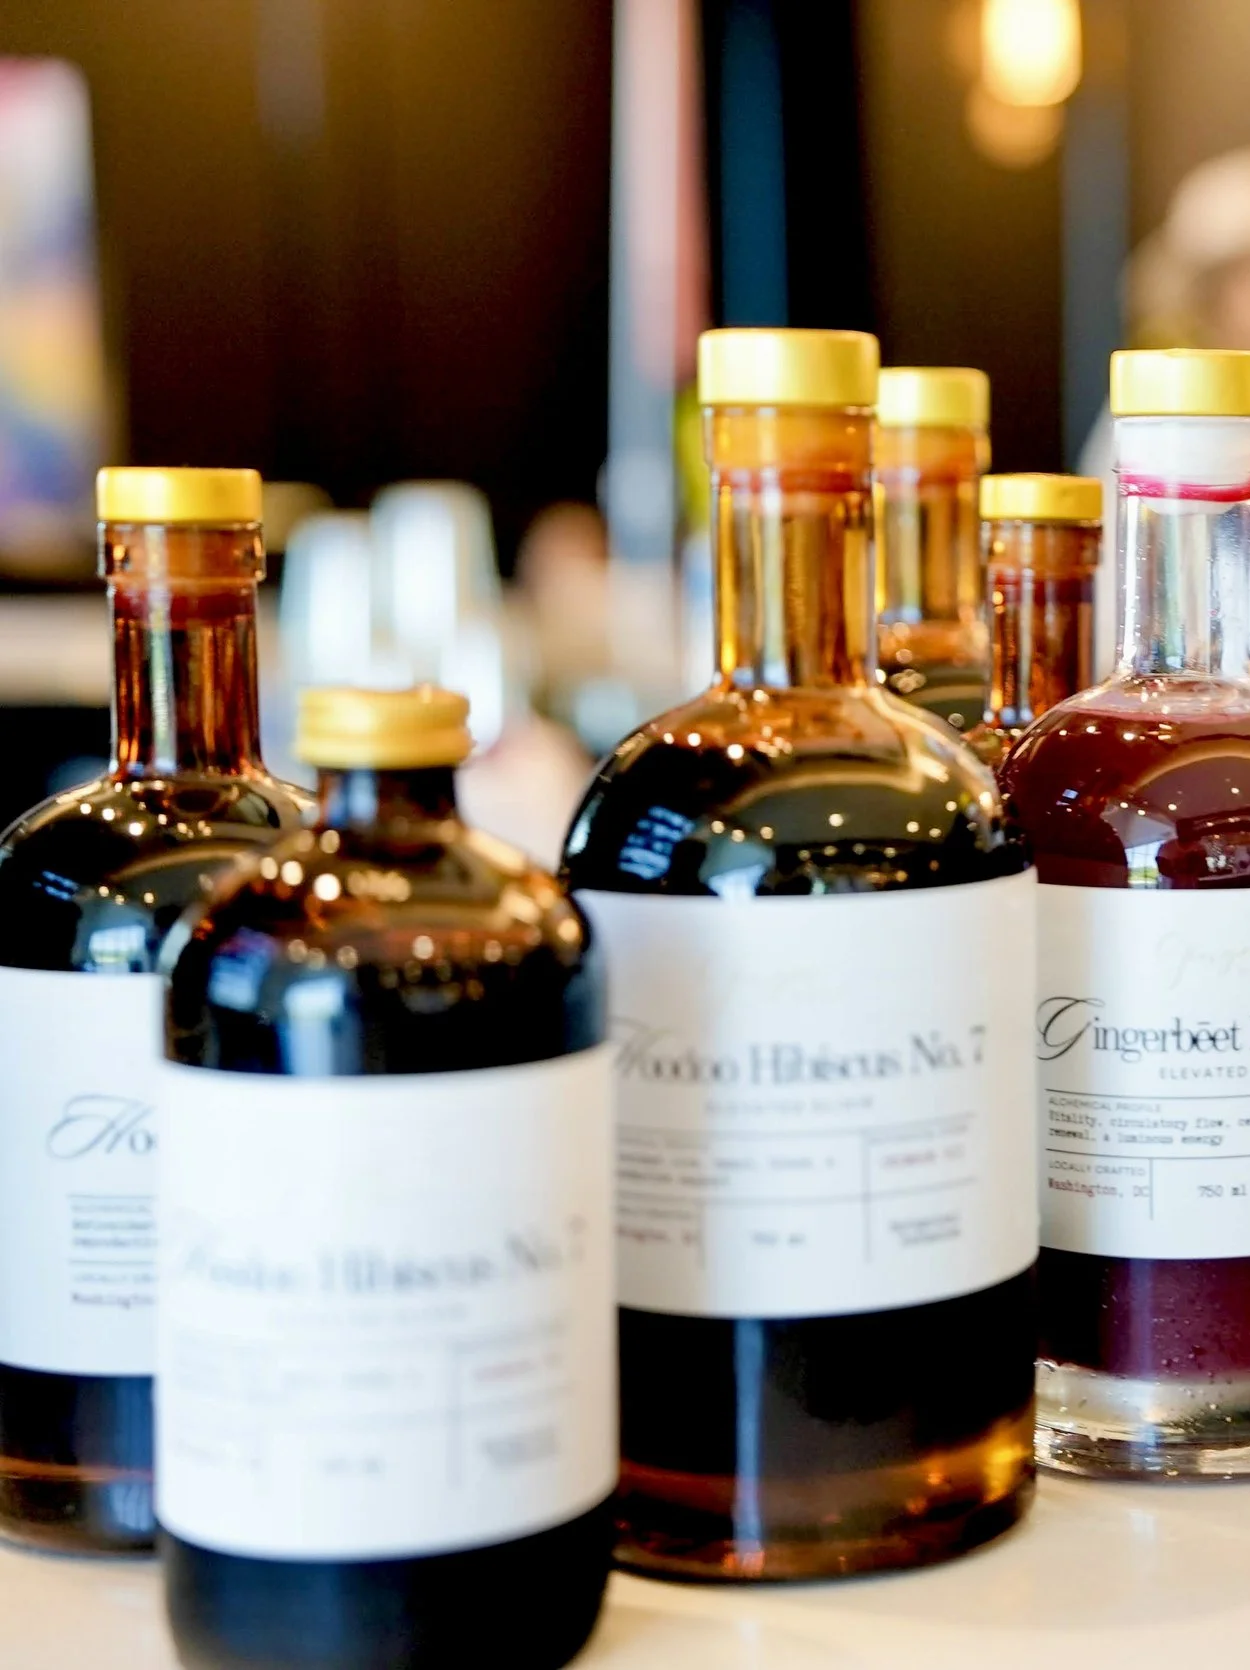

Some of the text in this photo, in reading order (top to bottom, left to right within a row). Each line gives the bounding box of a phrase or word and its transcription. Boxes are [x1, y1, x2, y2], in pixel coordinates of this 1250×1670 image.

[1159, 1065, 1248, 1080] ELEVATED
[1181, 1134, 1223, 1147] energy
[1047, 1177, 1151, 1199] Washington, DC
[1196, 1184, 1224, 1198] 750
